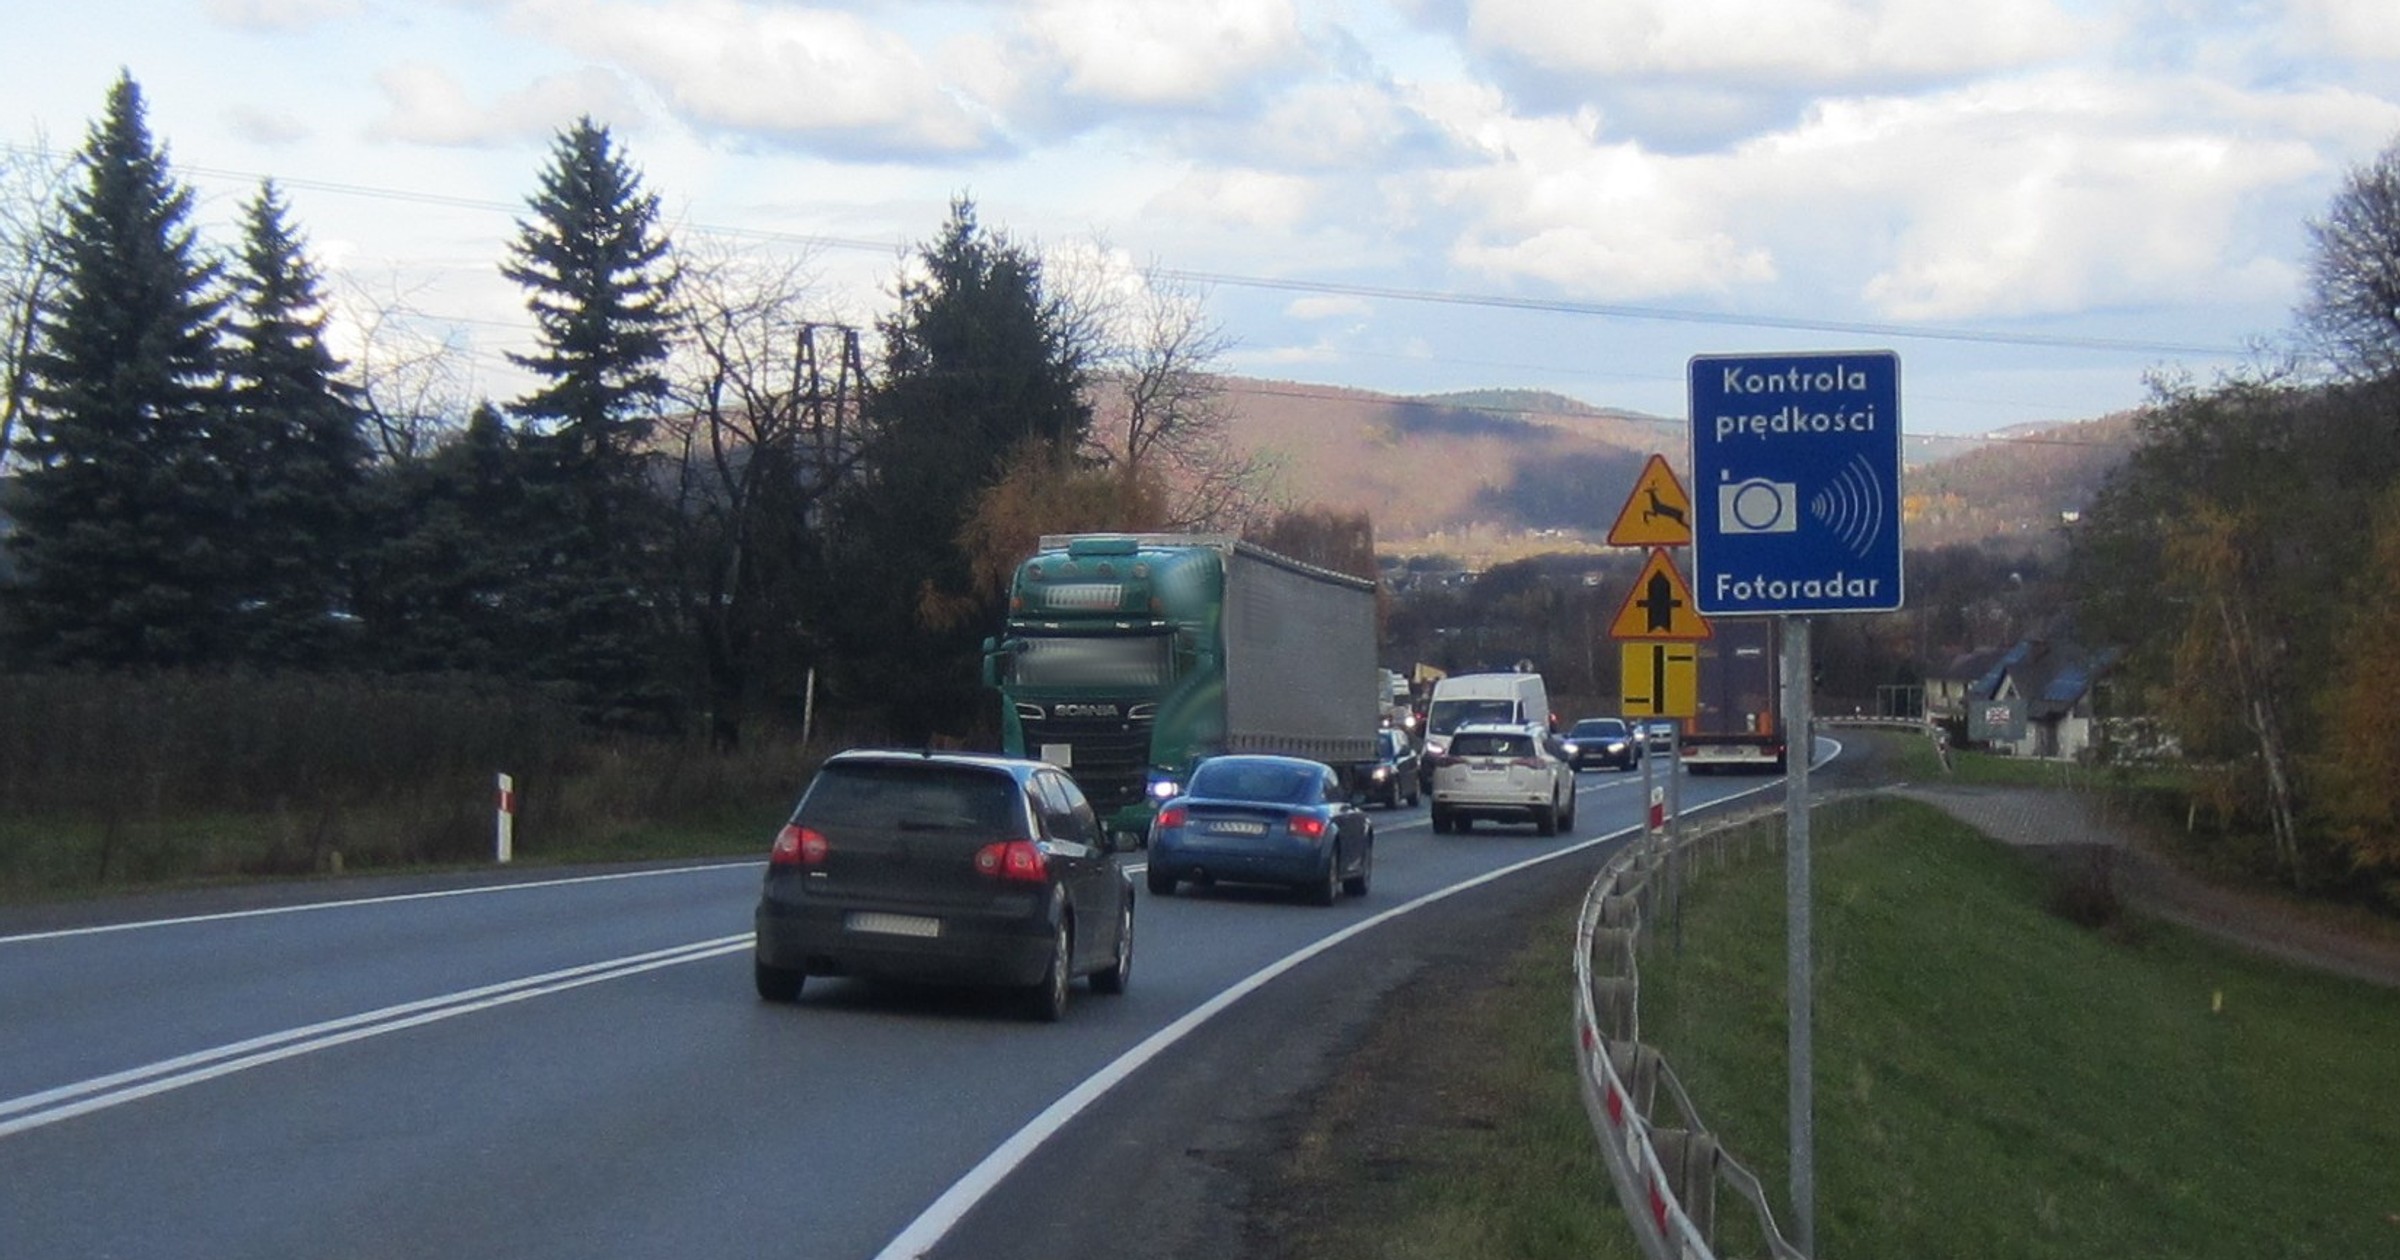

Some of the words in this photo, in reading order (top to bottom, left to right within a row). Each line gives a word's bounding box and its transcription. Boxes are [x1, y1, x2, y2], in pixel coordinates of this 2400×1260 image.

[1724, 365, 1866, 393] Kontrola
[1716, 404, 1875, 442] prędkości
[1716, 572, 1879, 600] Fotoradar
